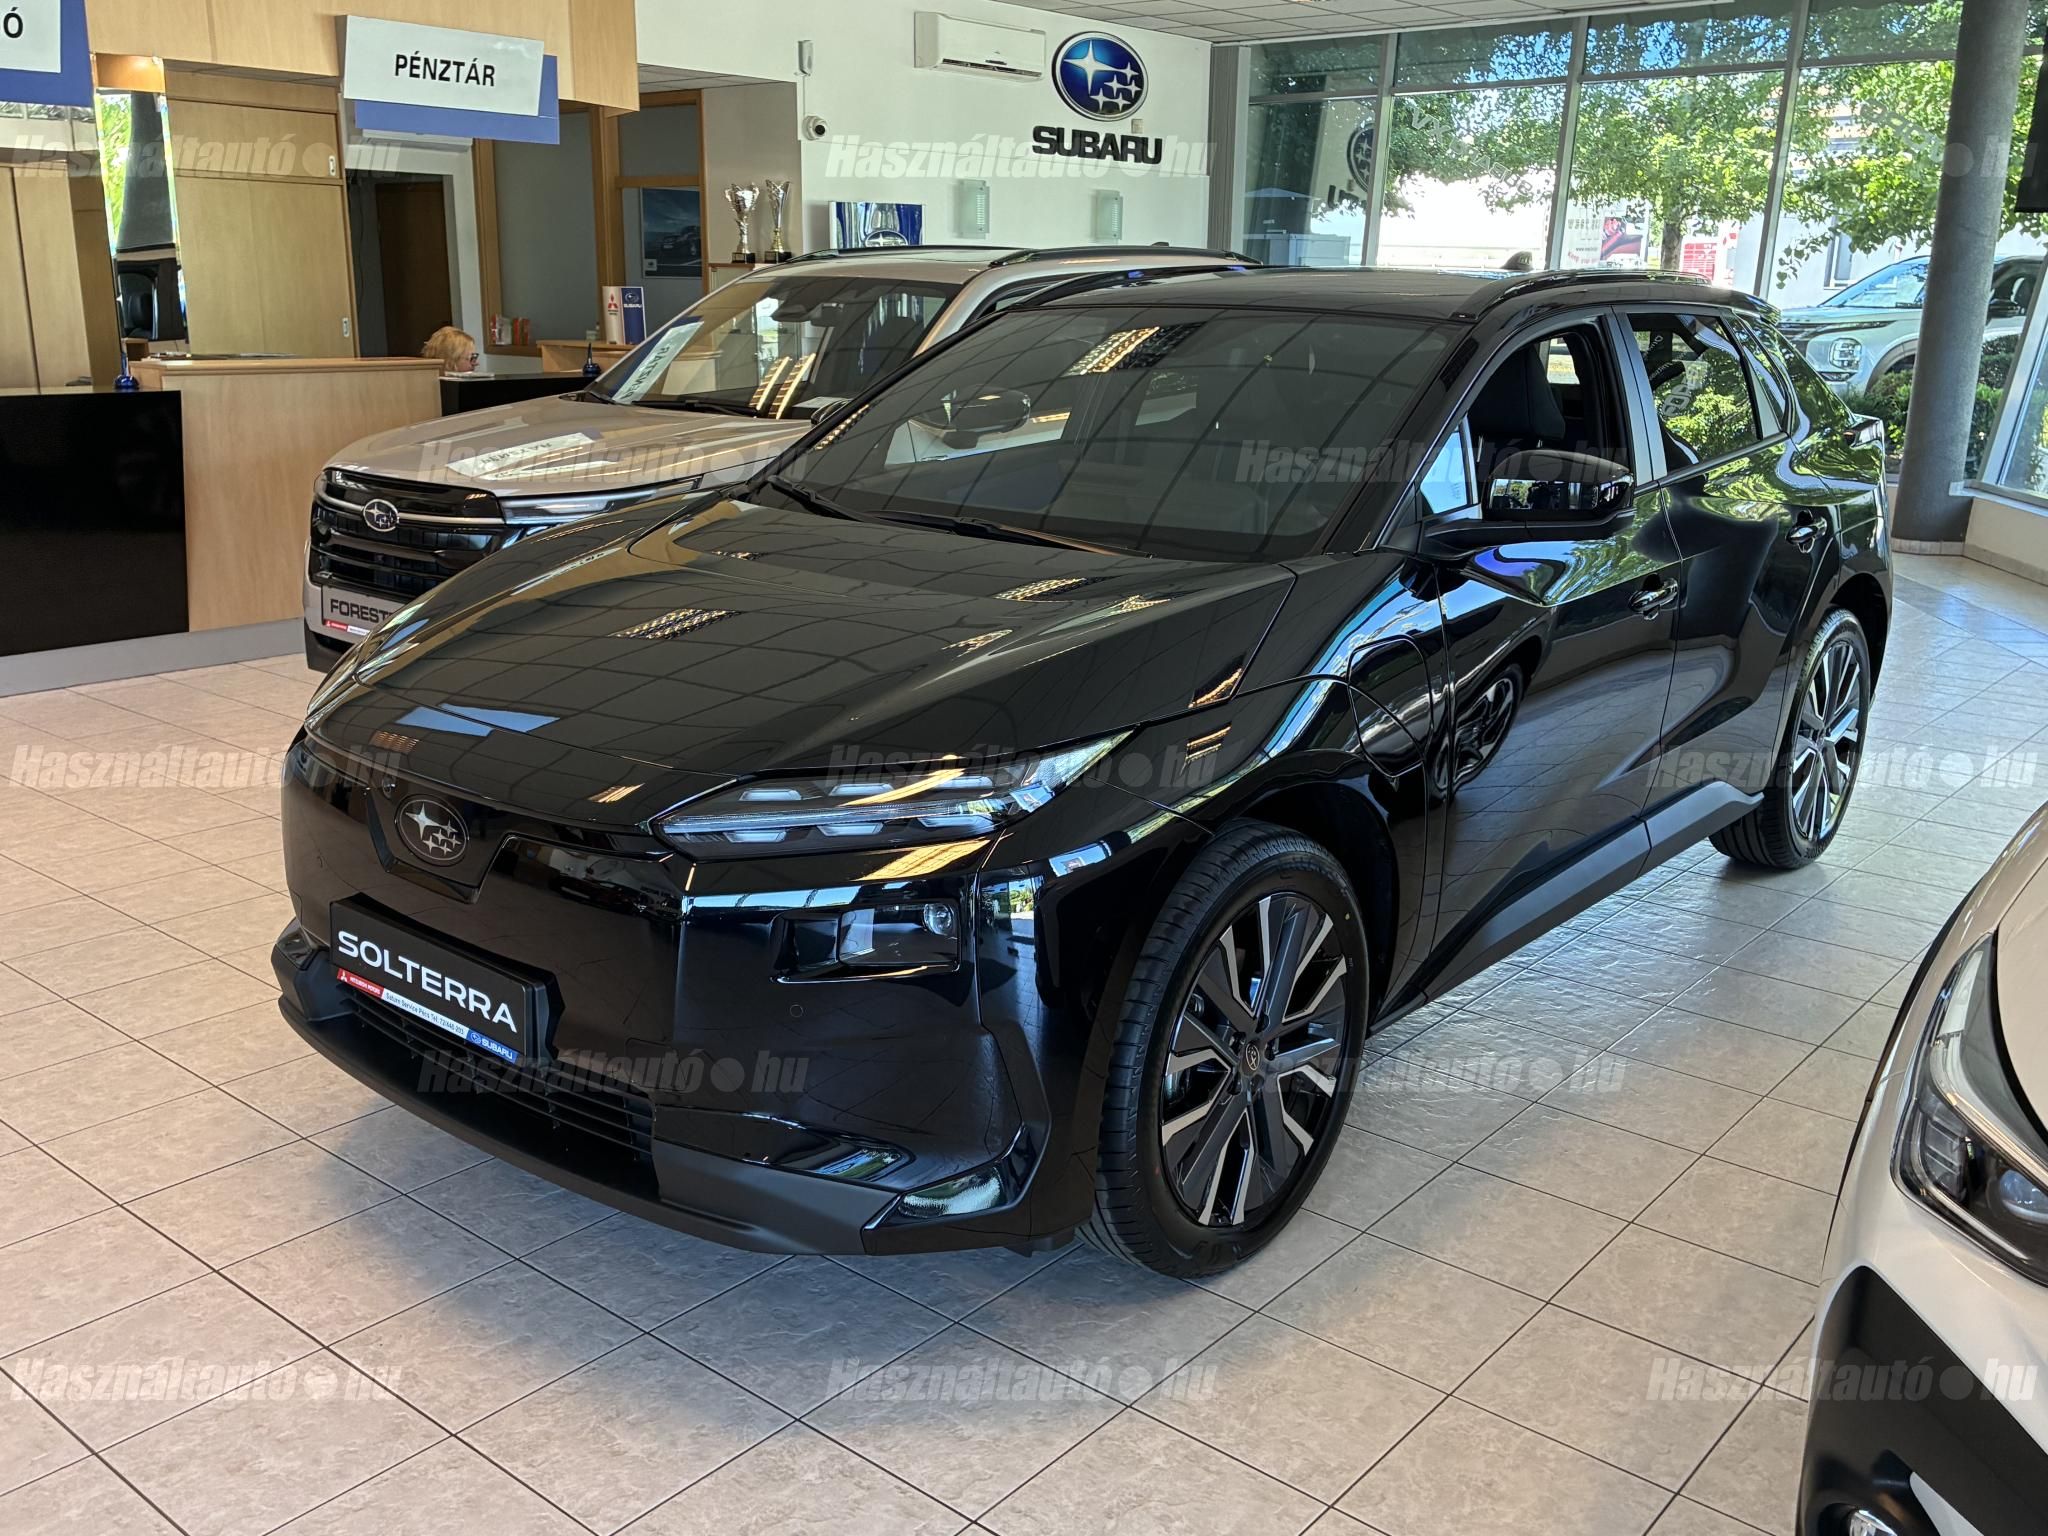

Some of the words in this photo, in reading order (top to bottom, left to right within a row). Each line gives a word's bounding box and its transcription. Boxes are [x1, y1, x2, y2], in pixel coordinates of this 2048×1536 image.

[394, 50, 495, 87] PÉNZTÁR
[1032, 125, 1163, 165] SUBARU
[330, 598, 394, 624] FOREST
[337, 930, 518, 1033] SOLTERRA
[481, 1038, 513, 1060] SUBARU
